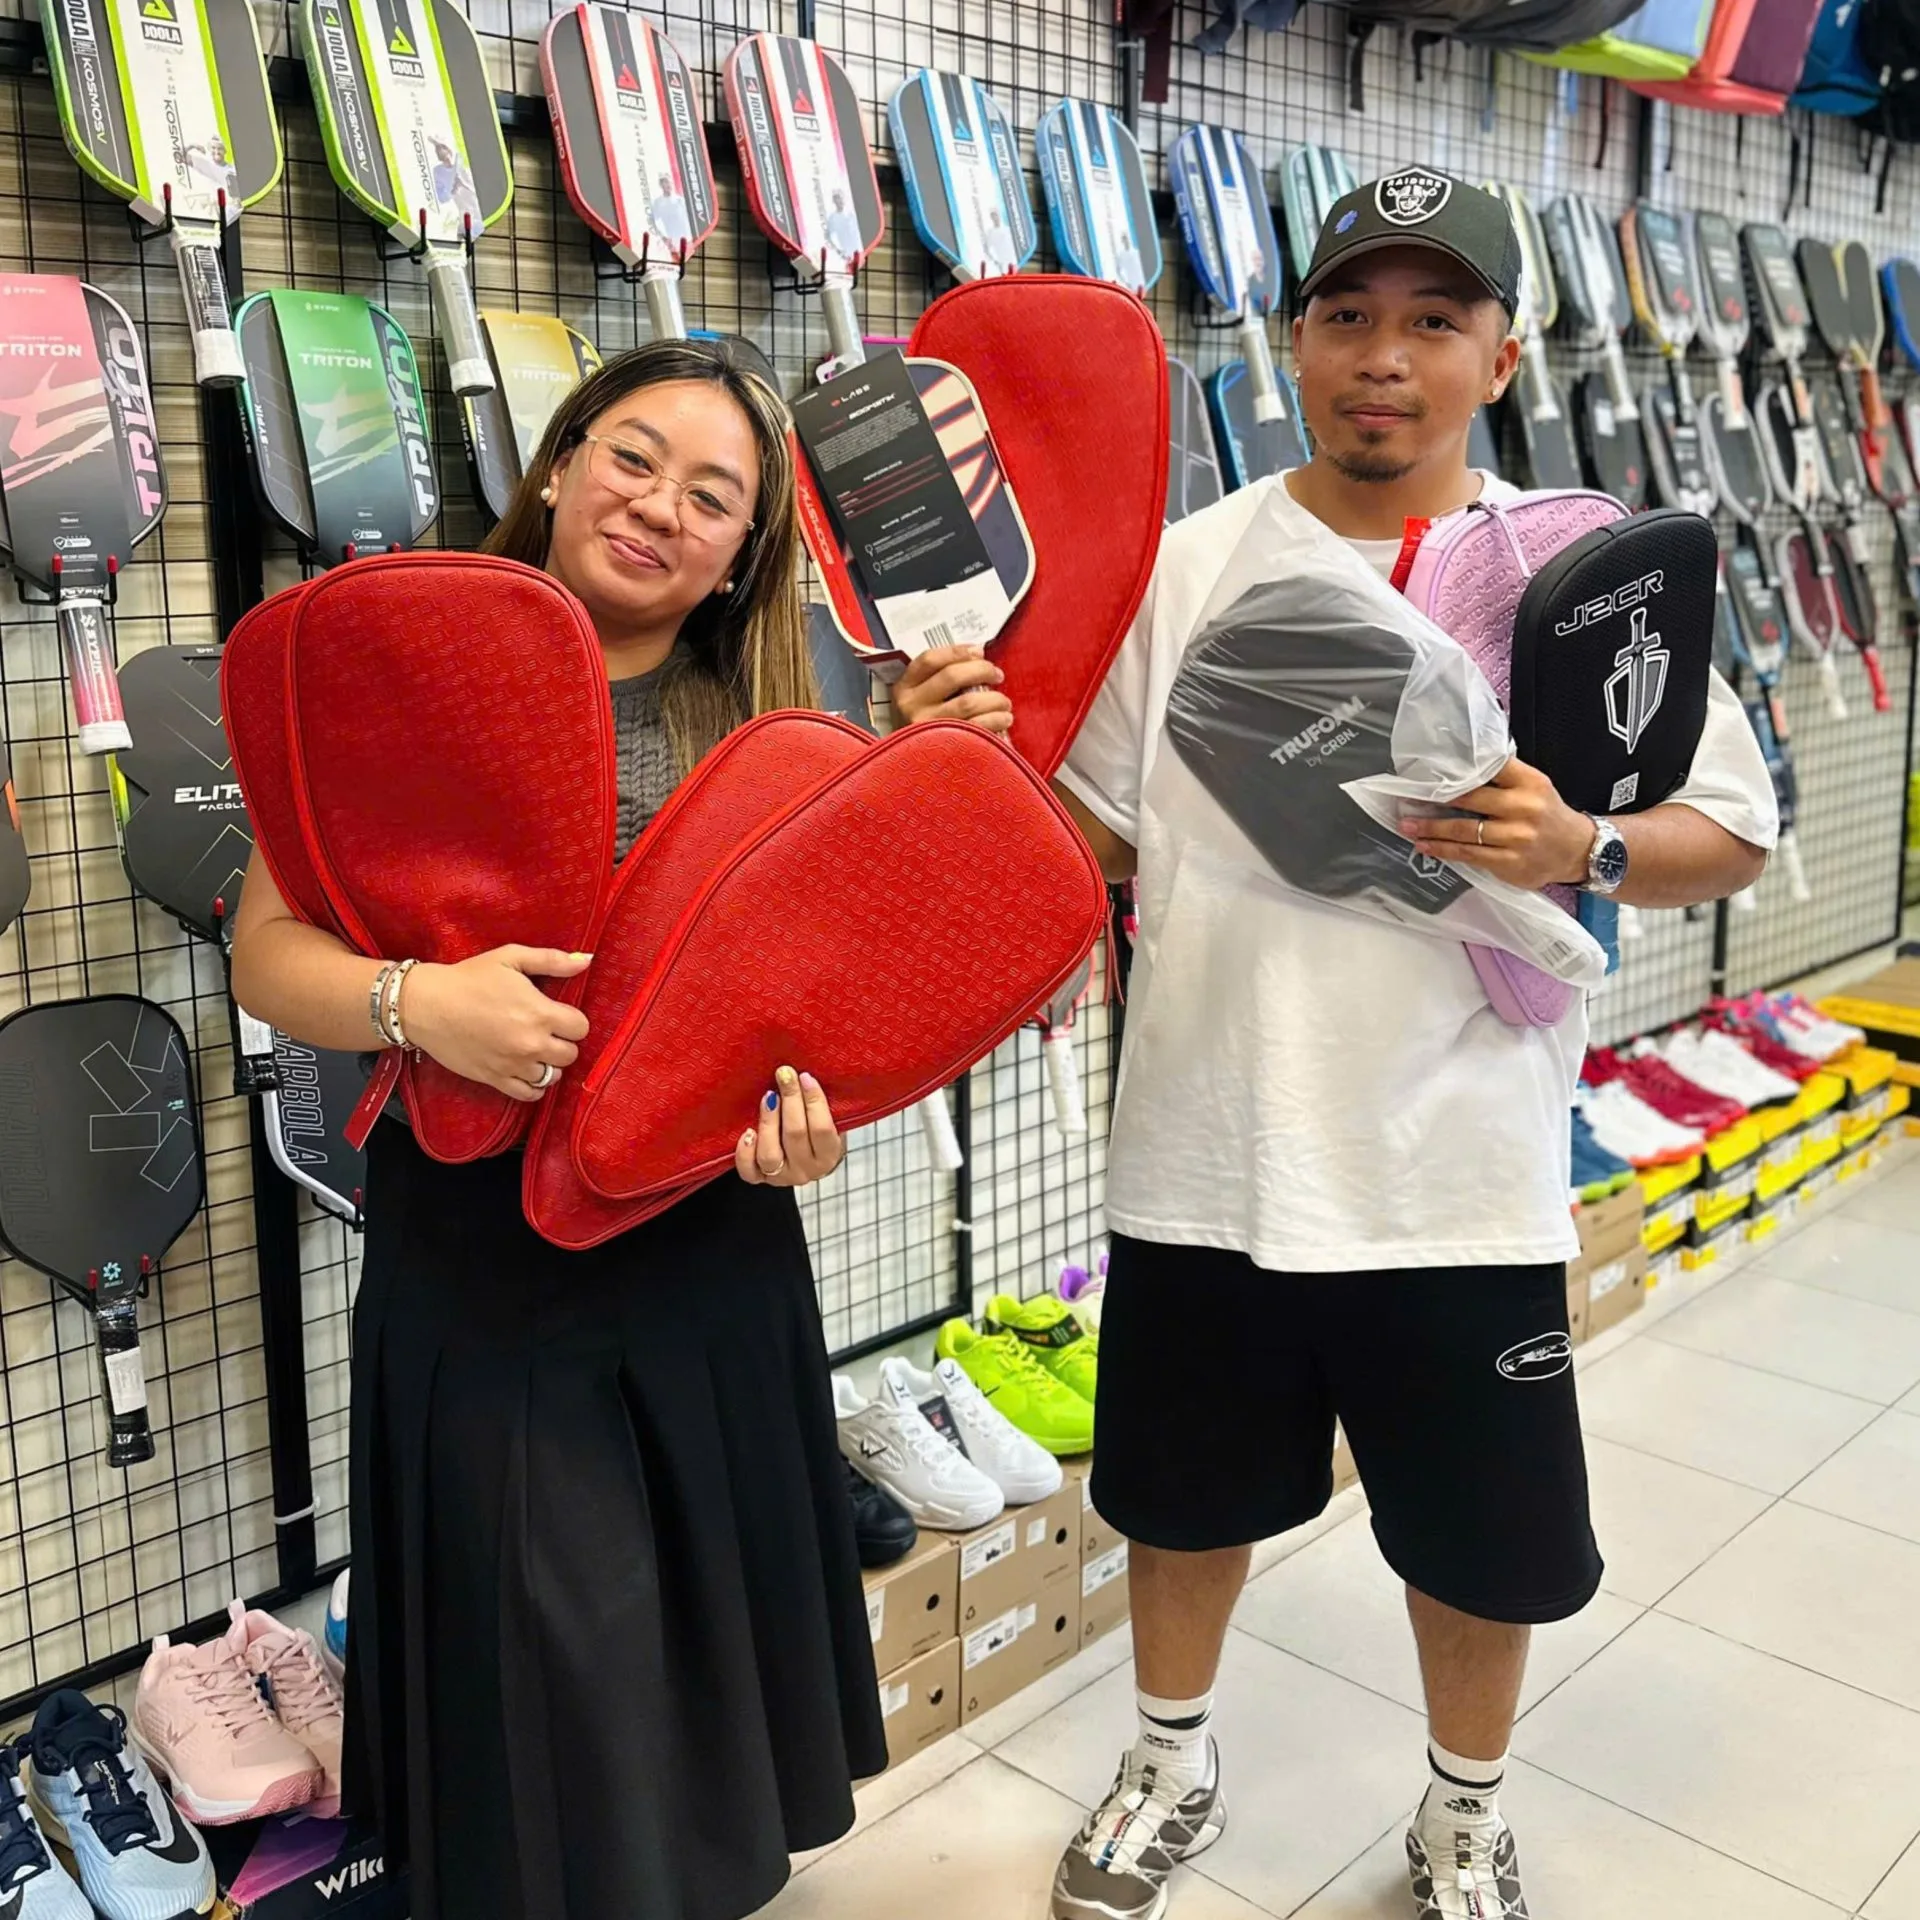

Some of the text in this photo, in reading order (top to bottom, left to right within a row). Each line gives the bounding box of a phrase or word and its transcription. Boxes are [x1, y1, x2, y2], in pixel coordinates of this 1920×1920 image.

[144, 23, 181, 44] JOOLA
[327, 28, 349, 73] JOOLA
[392, 59, 424, 78] JOOLA
[1386, 177, 1442, 188] RAIDERS
[298, 352, 373, 369] TRITON
[510, 368, 573, 383] TRITON
[254, 403, 269, 445] SYPIK
[1555, 569, 1664, 636] J2CR
[1305, 754, 1323, 767] by
[1444, 1801, 1488, 1815] adidas
